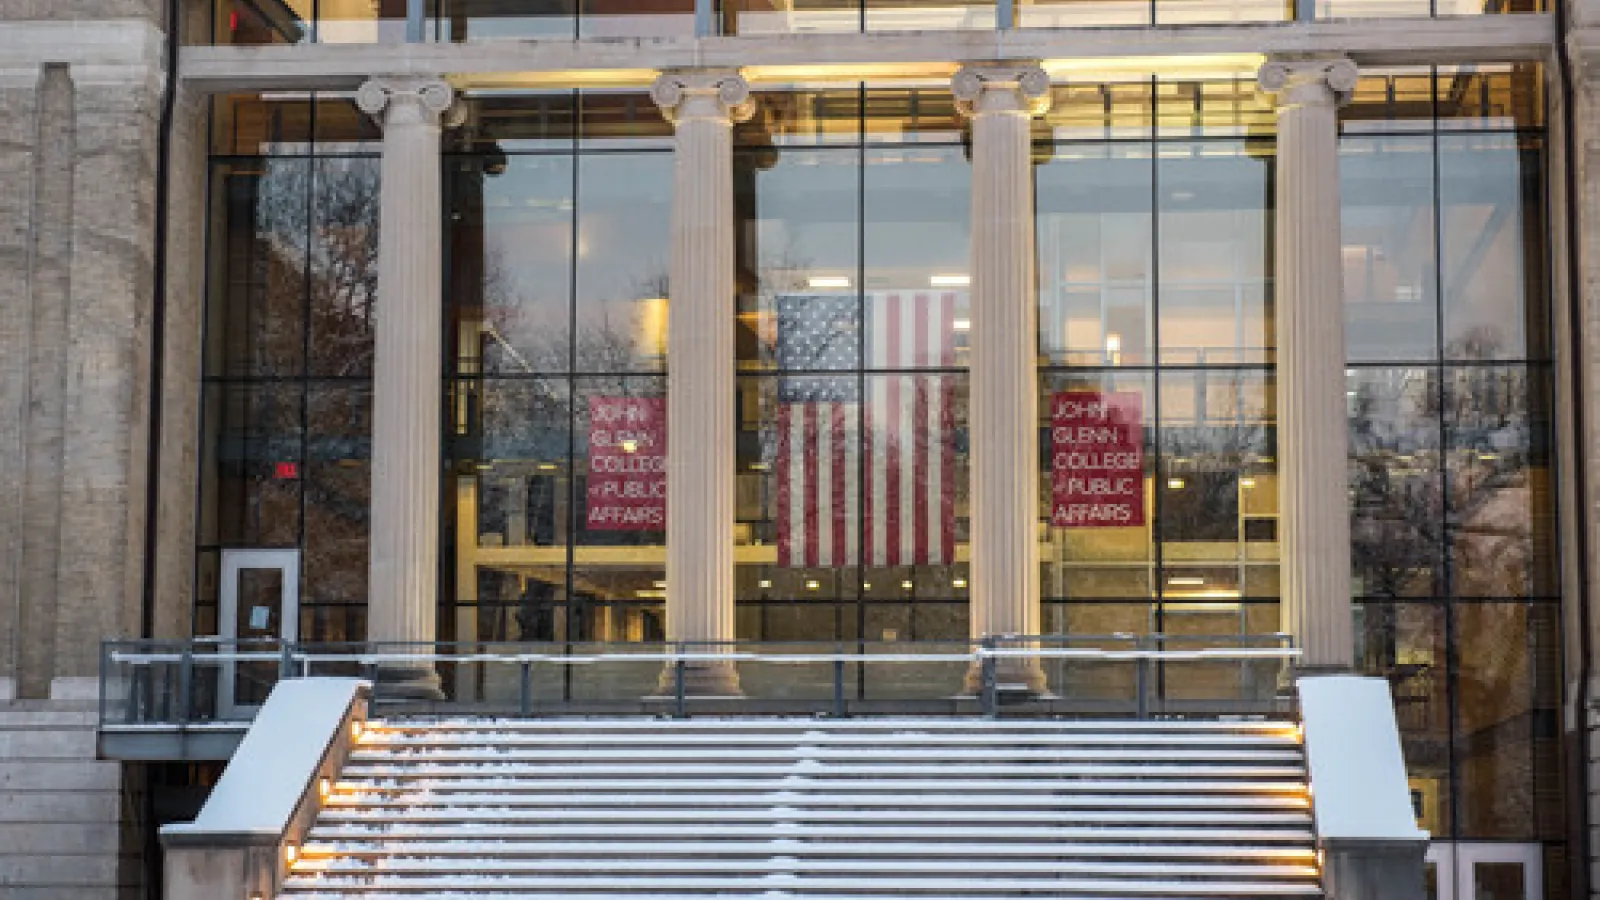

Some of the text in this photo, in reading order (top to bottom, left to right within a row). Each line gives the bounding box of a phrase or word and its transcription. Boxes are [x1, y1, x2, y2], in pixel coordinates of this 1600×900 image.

[1053, 401, 1108, 418] JOHN
[1053, 426, 1118, 443] GLENN
[591, 455, 666, 472] COLLEG
[1053, 452, 1140, 469] COLLEGE
[1068, 478, 1133, 495] PUBLIC
[588, 506, 664, 523] AFFAIRS
[1053, 503, 1131, 521] AFFAIRS
